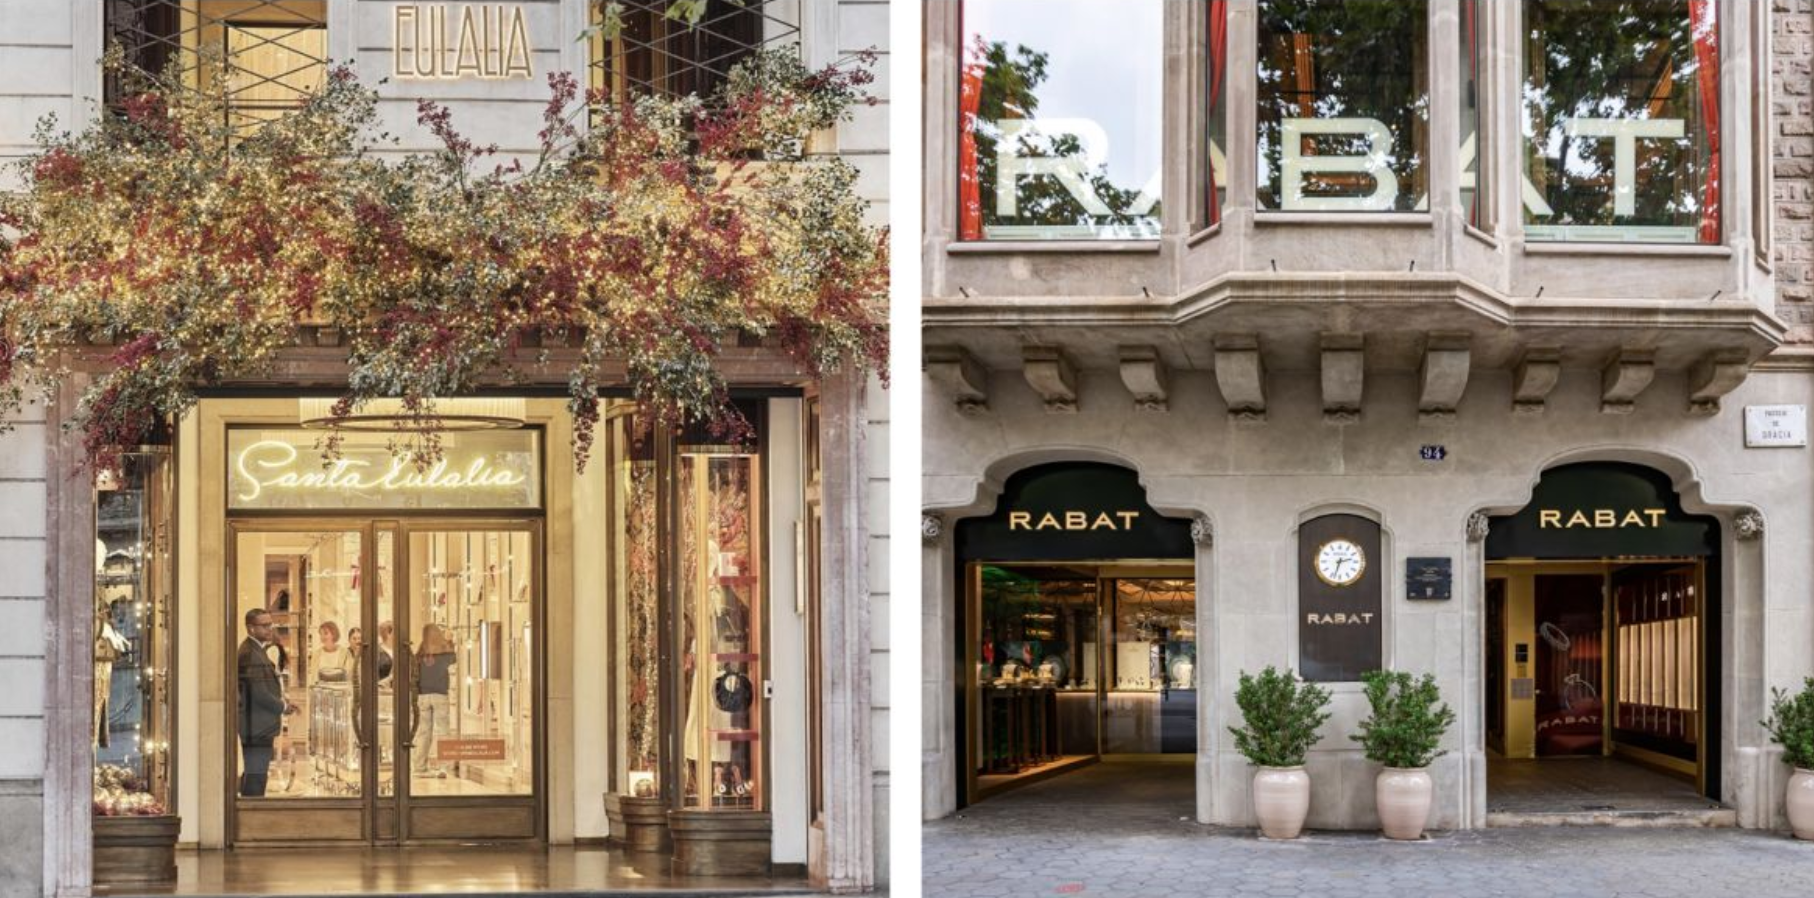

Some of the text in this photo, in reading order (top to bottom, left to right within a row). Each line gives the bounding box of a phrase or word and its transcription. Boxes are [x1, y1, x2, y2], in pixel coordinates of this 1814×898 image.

[396, 5, 532, 77] EULALIA
[1422, 446, 1442, 459] 94
[238, 440, 525, 501] Santa Eulalia
[1009, 511, 1140, 530] RABAT
[1539, 508, 1666, 529] RABAT
[1307, 612, 1373, 625] RABAT
